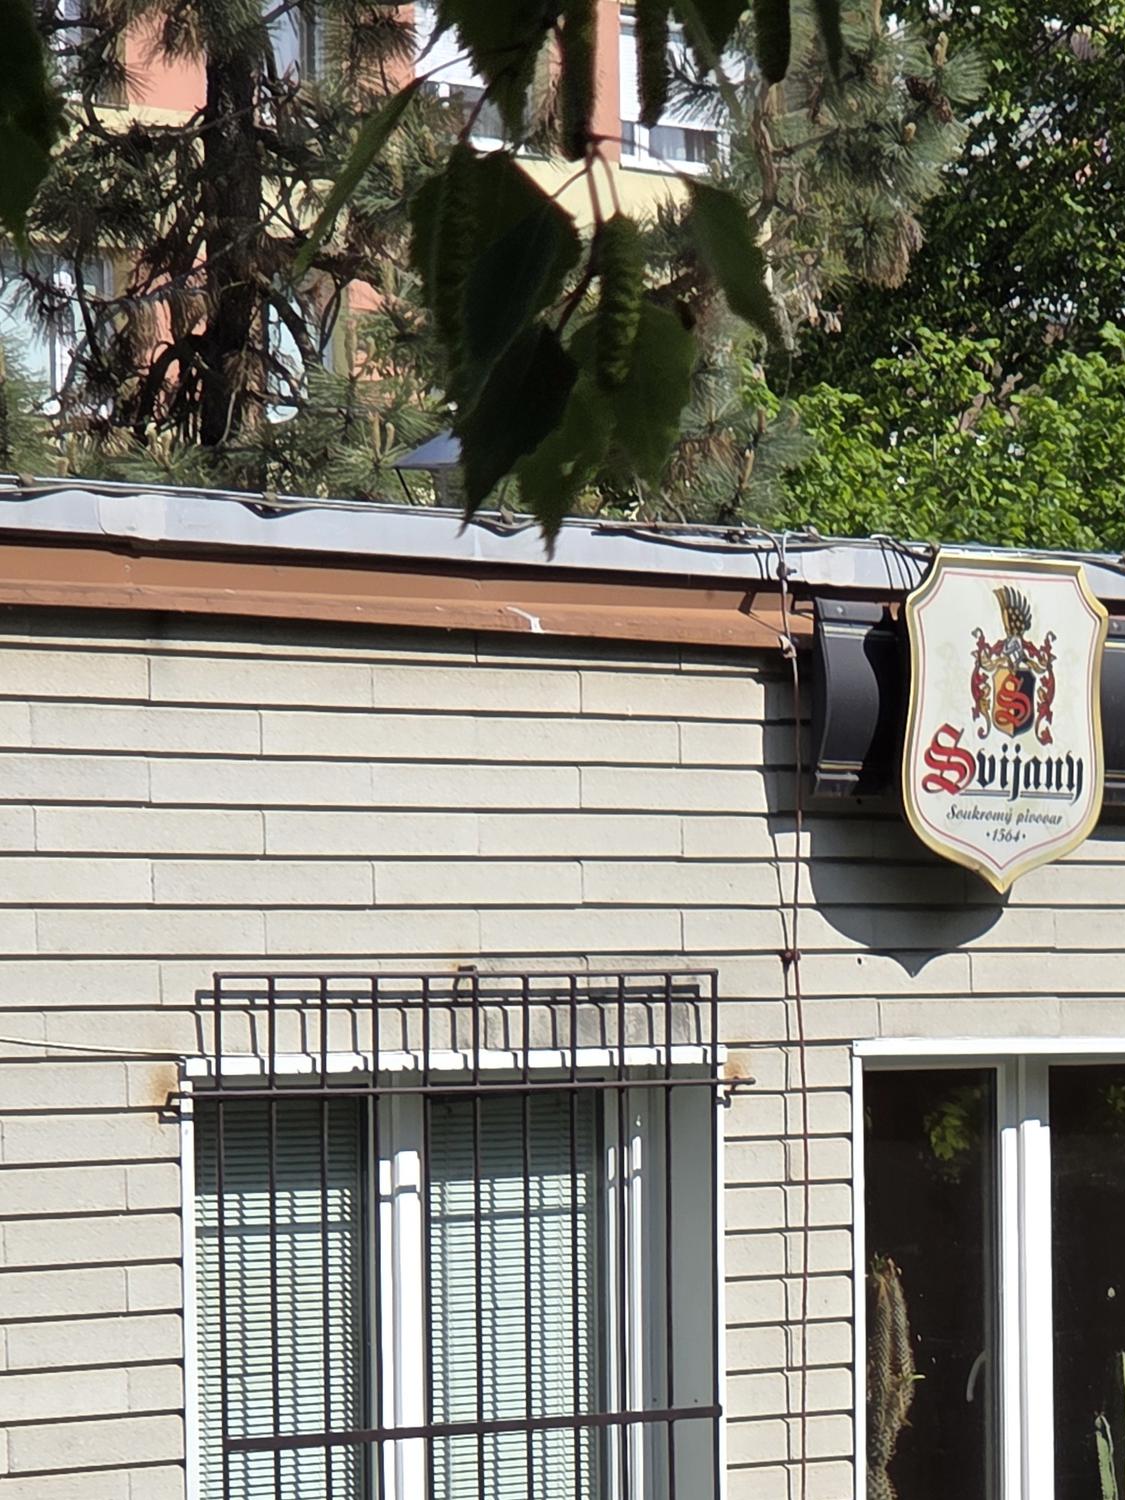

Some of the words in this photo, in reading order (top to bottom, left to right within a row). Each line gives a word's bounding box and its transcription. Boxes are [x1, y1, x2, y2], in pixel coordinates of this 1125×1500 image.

[921, 723, 1084, 806] Svijany
[946, 804, 1014, 826] Soukromý
[1015, 808, 1063, 826] pivovar
